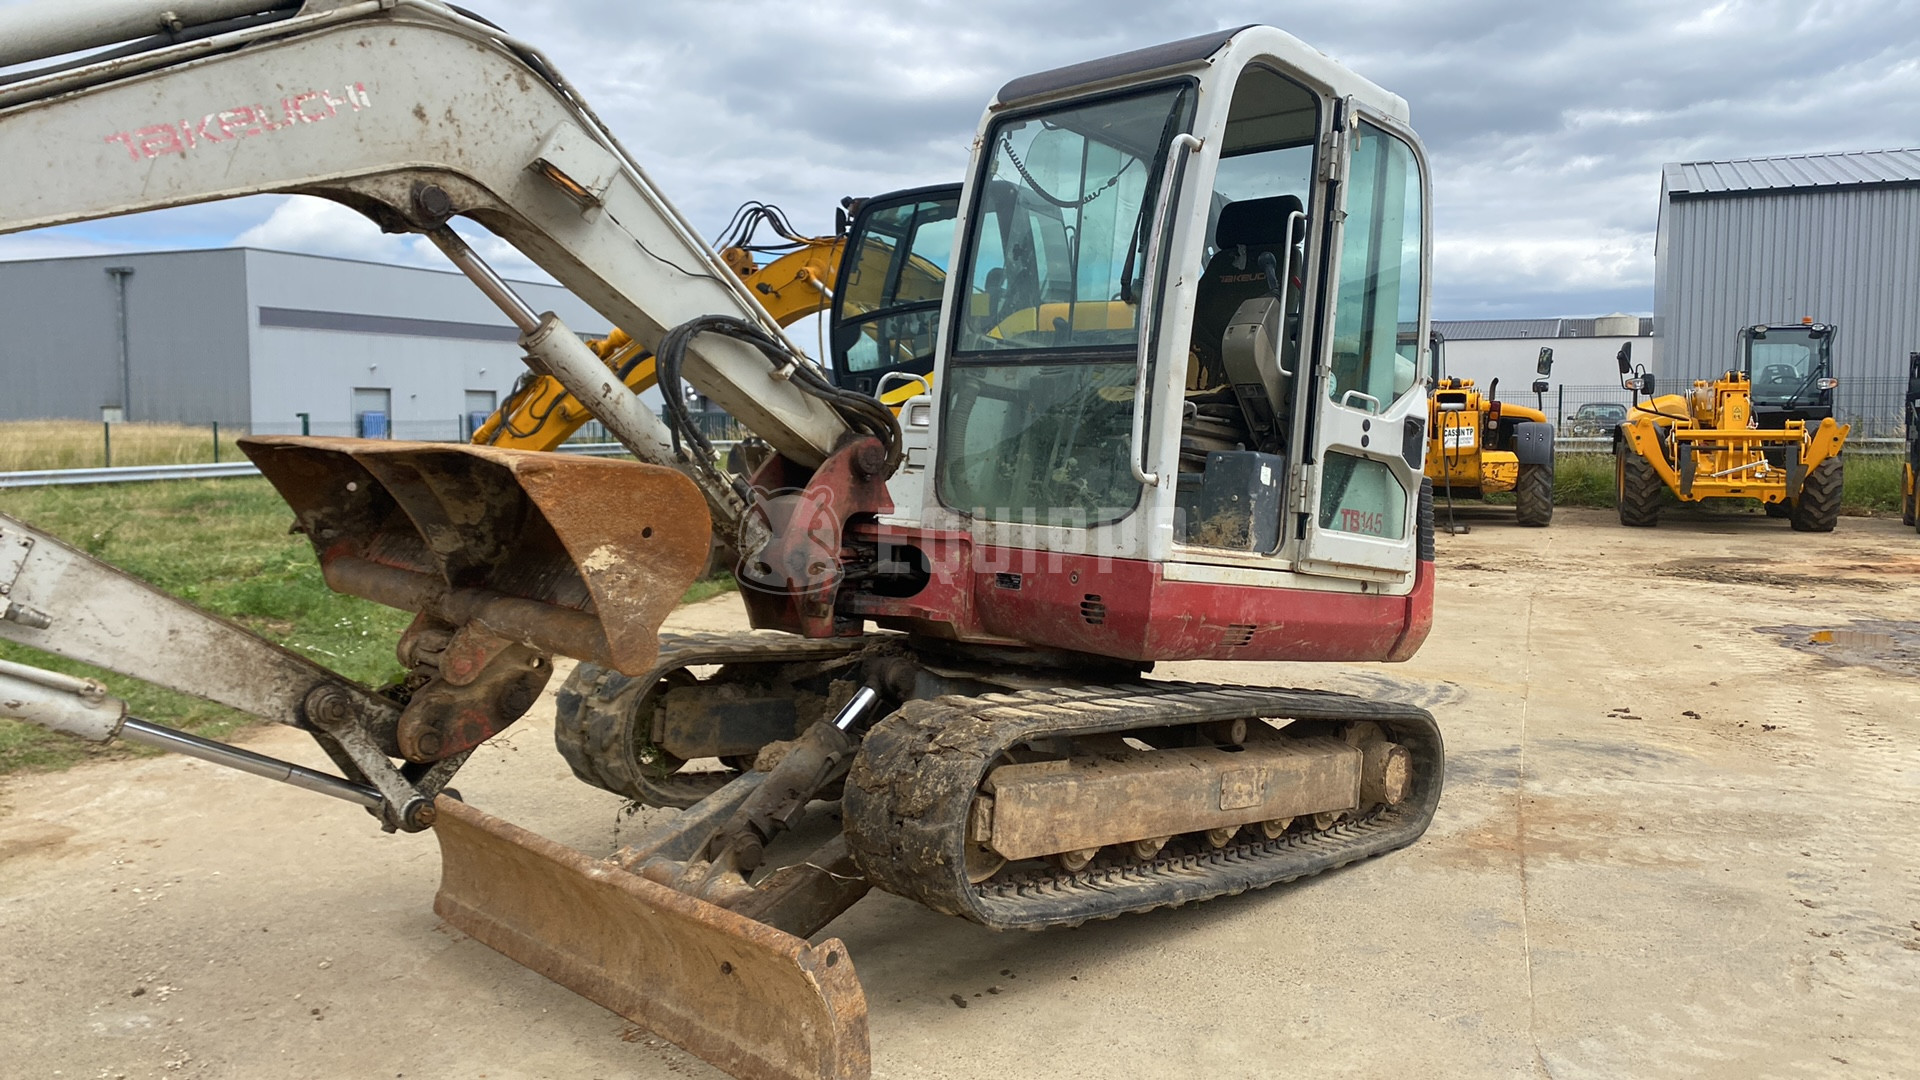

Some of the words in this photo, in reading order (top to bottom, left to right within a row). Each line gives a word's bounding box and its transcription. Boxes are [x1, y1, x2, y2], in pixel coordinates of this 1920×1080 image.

[103, 82, 371, 162] TAKEUCHI
[1220, 272, 1268, 283] TAKEUC
[1341, 508, 1383, 534] TB145
